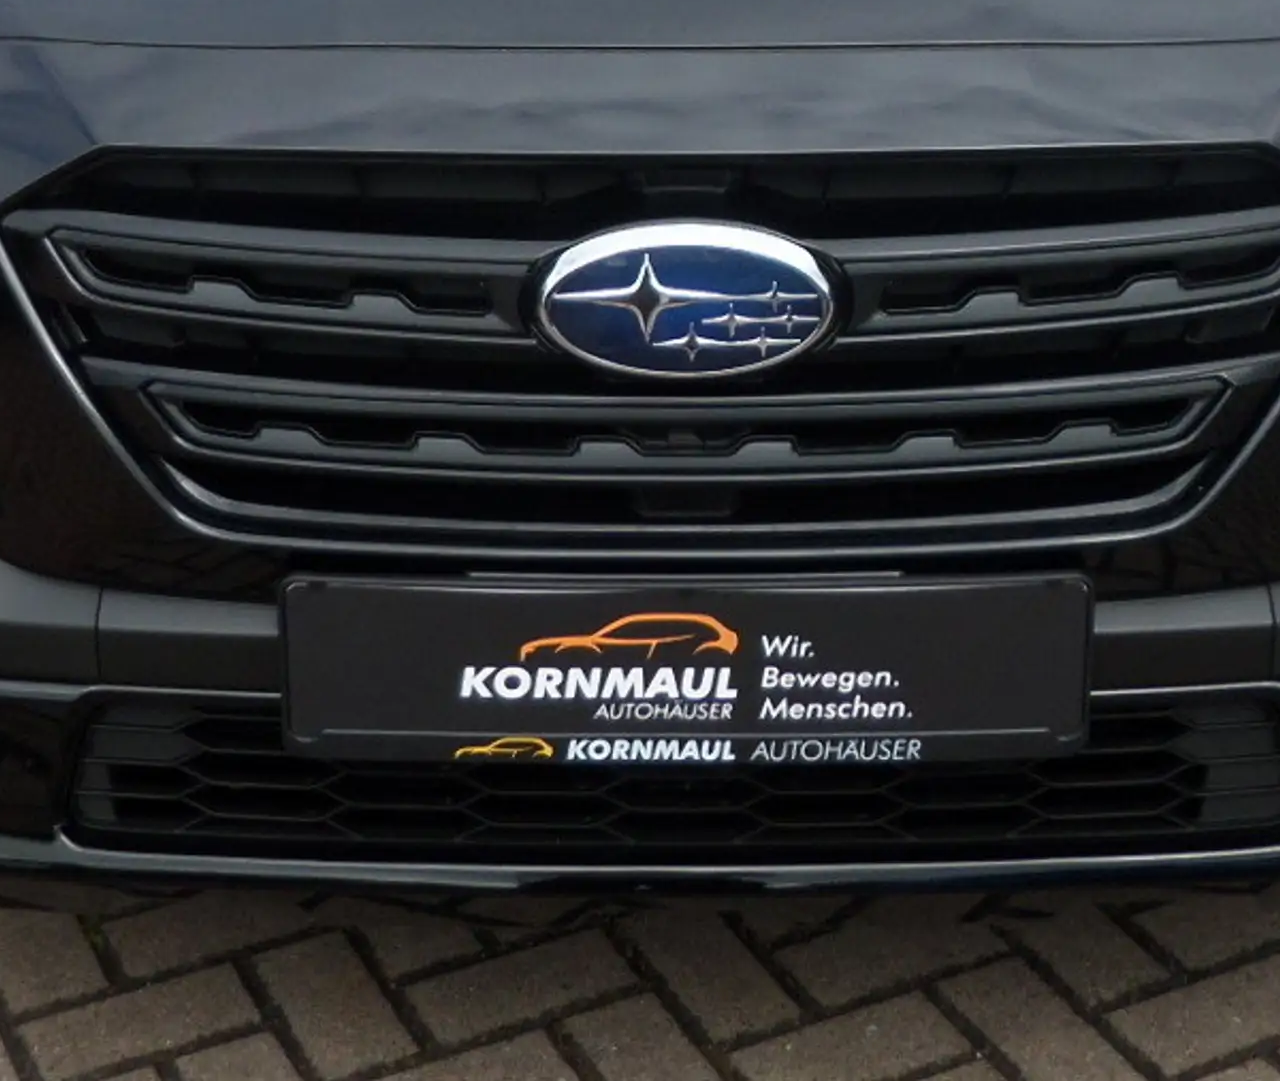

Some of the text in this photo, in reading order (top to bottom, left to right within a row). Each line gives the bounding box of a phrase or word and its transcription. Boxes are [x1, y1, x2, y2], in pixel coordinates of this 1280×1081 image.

[761, 635, 815, 658] Wir.
[459, 666, 738, 699] KORNMAUL
[761, 666, 900, 693] Bewegen.
[593, 699, 734, 720] AUTOHÄUSER
[759, 695, 913, 719] Menschen.
[567, 738, 922, 762] KORNMAUL AUTOHÄUSER
